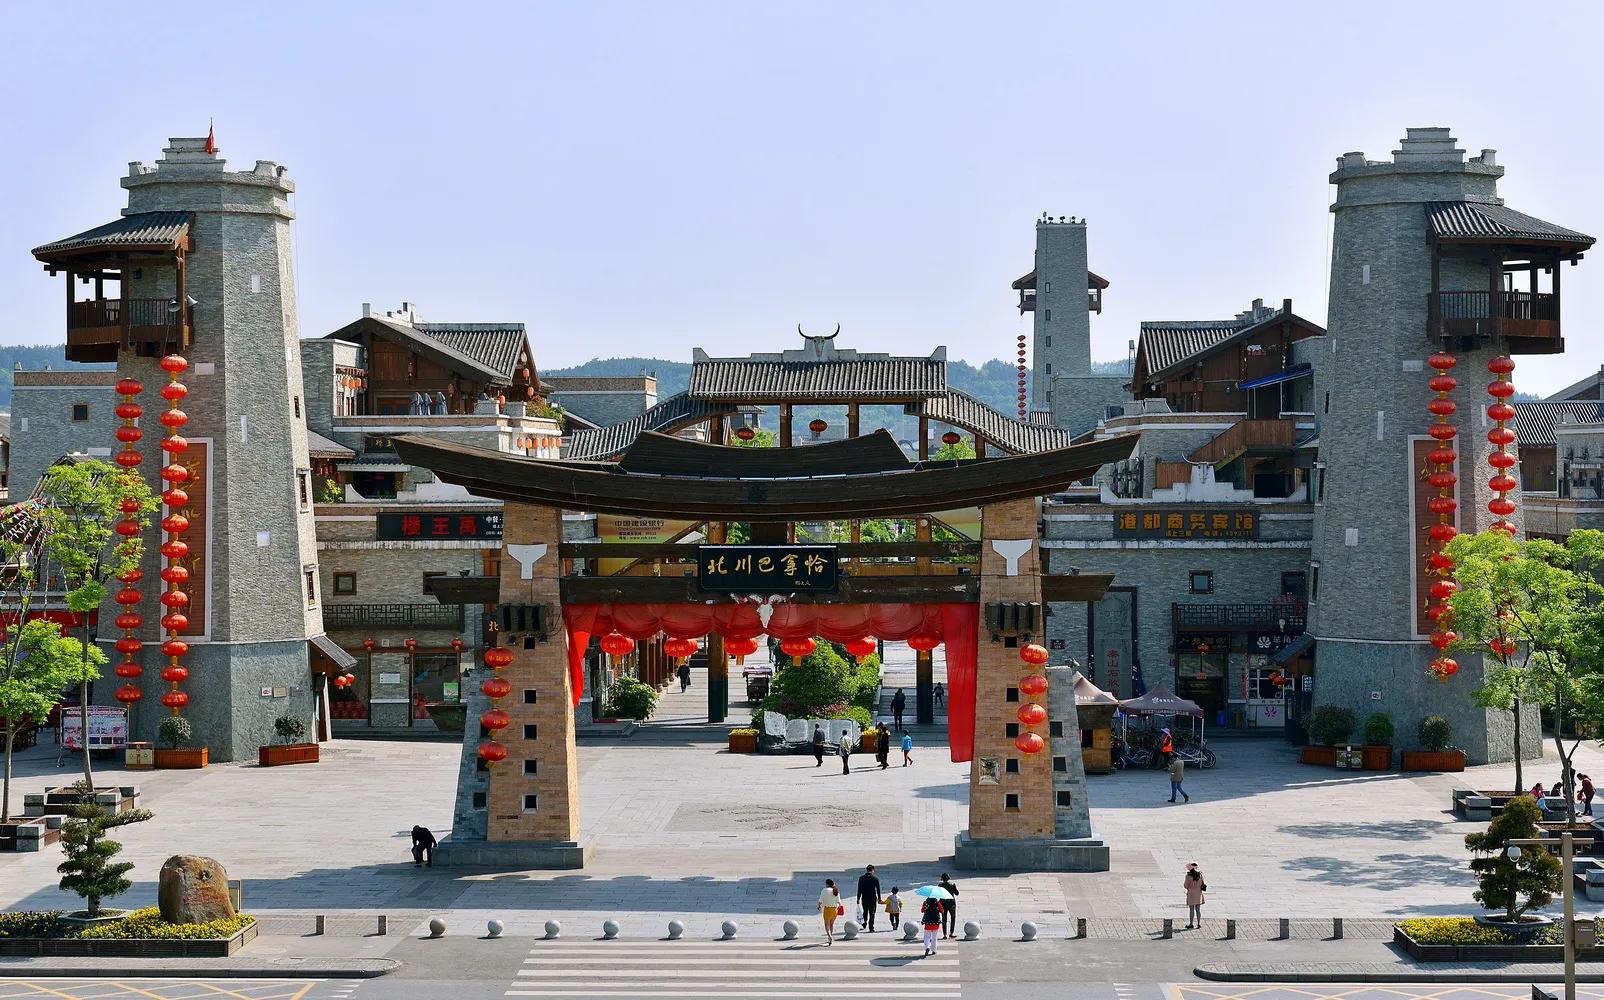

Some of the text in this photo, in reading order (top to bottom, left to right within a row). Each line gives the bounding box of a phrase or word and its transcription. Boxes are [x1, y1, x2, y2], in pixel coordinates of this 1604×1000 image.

[1120, 513, 1253, 529] 港都商务宾馆
[707, 554, 828, 576] 北川巴拿恰
